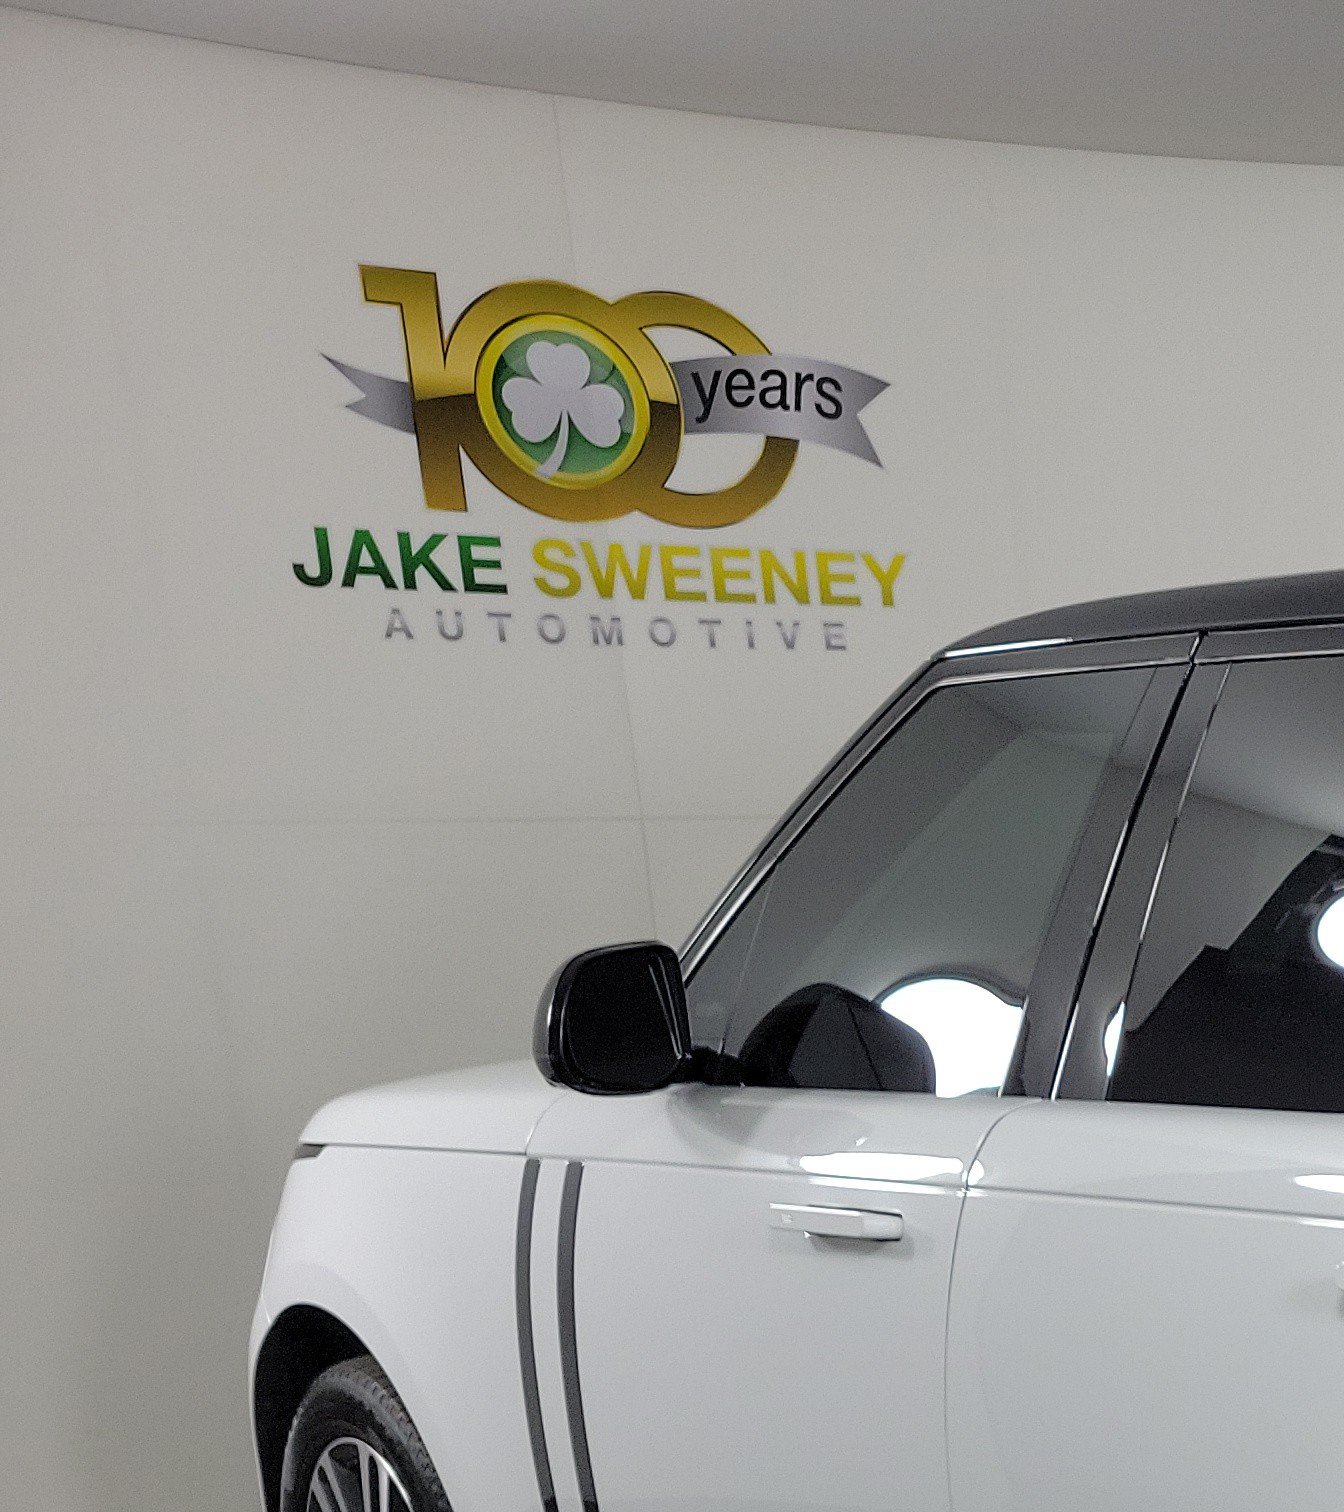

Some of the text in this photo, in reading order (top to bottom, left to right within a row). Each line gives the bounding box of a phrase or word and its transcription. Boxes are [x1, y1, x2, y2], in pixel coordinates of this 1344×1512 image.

[357, 263, 844, 530] 100 years
[292, 526, 907, 608] JAKE SWEENEY
[384, 608, 848, 652] AUTOMOTIVE
